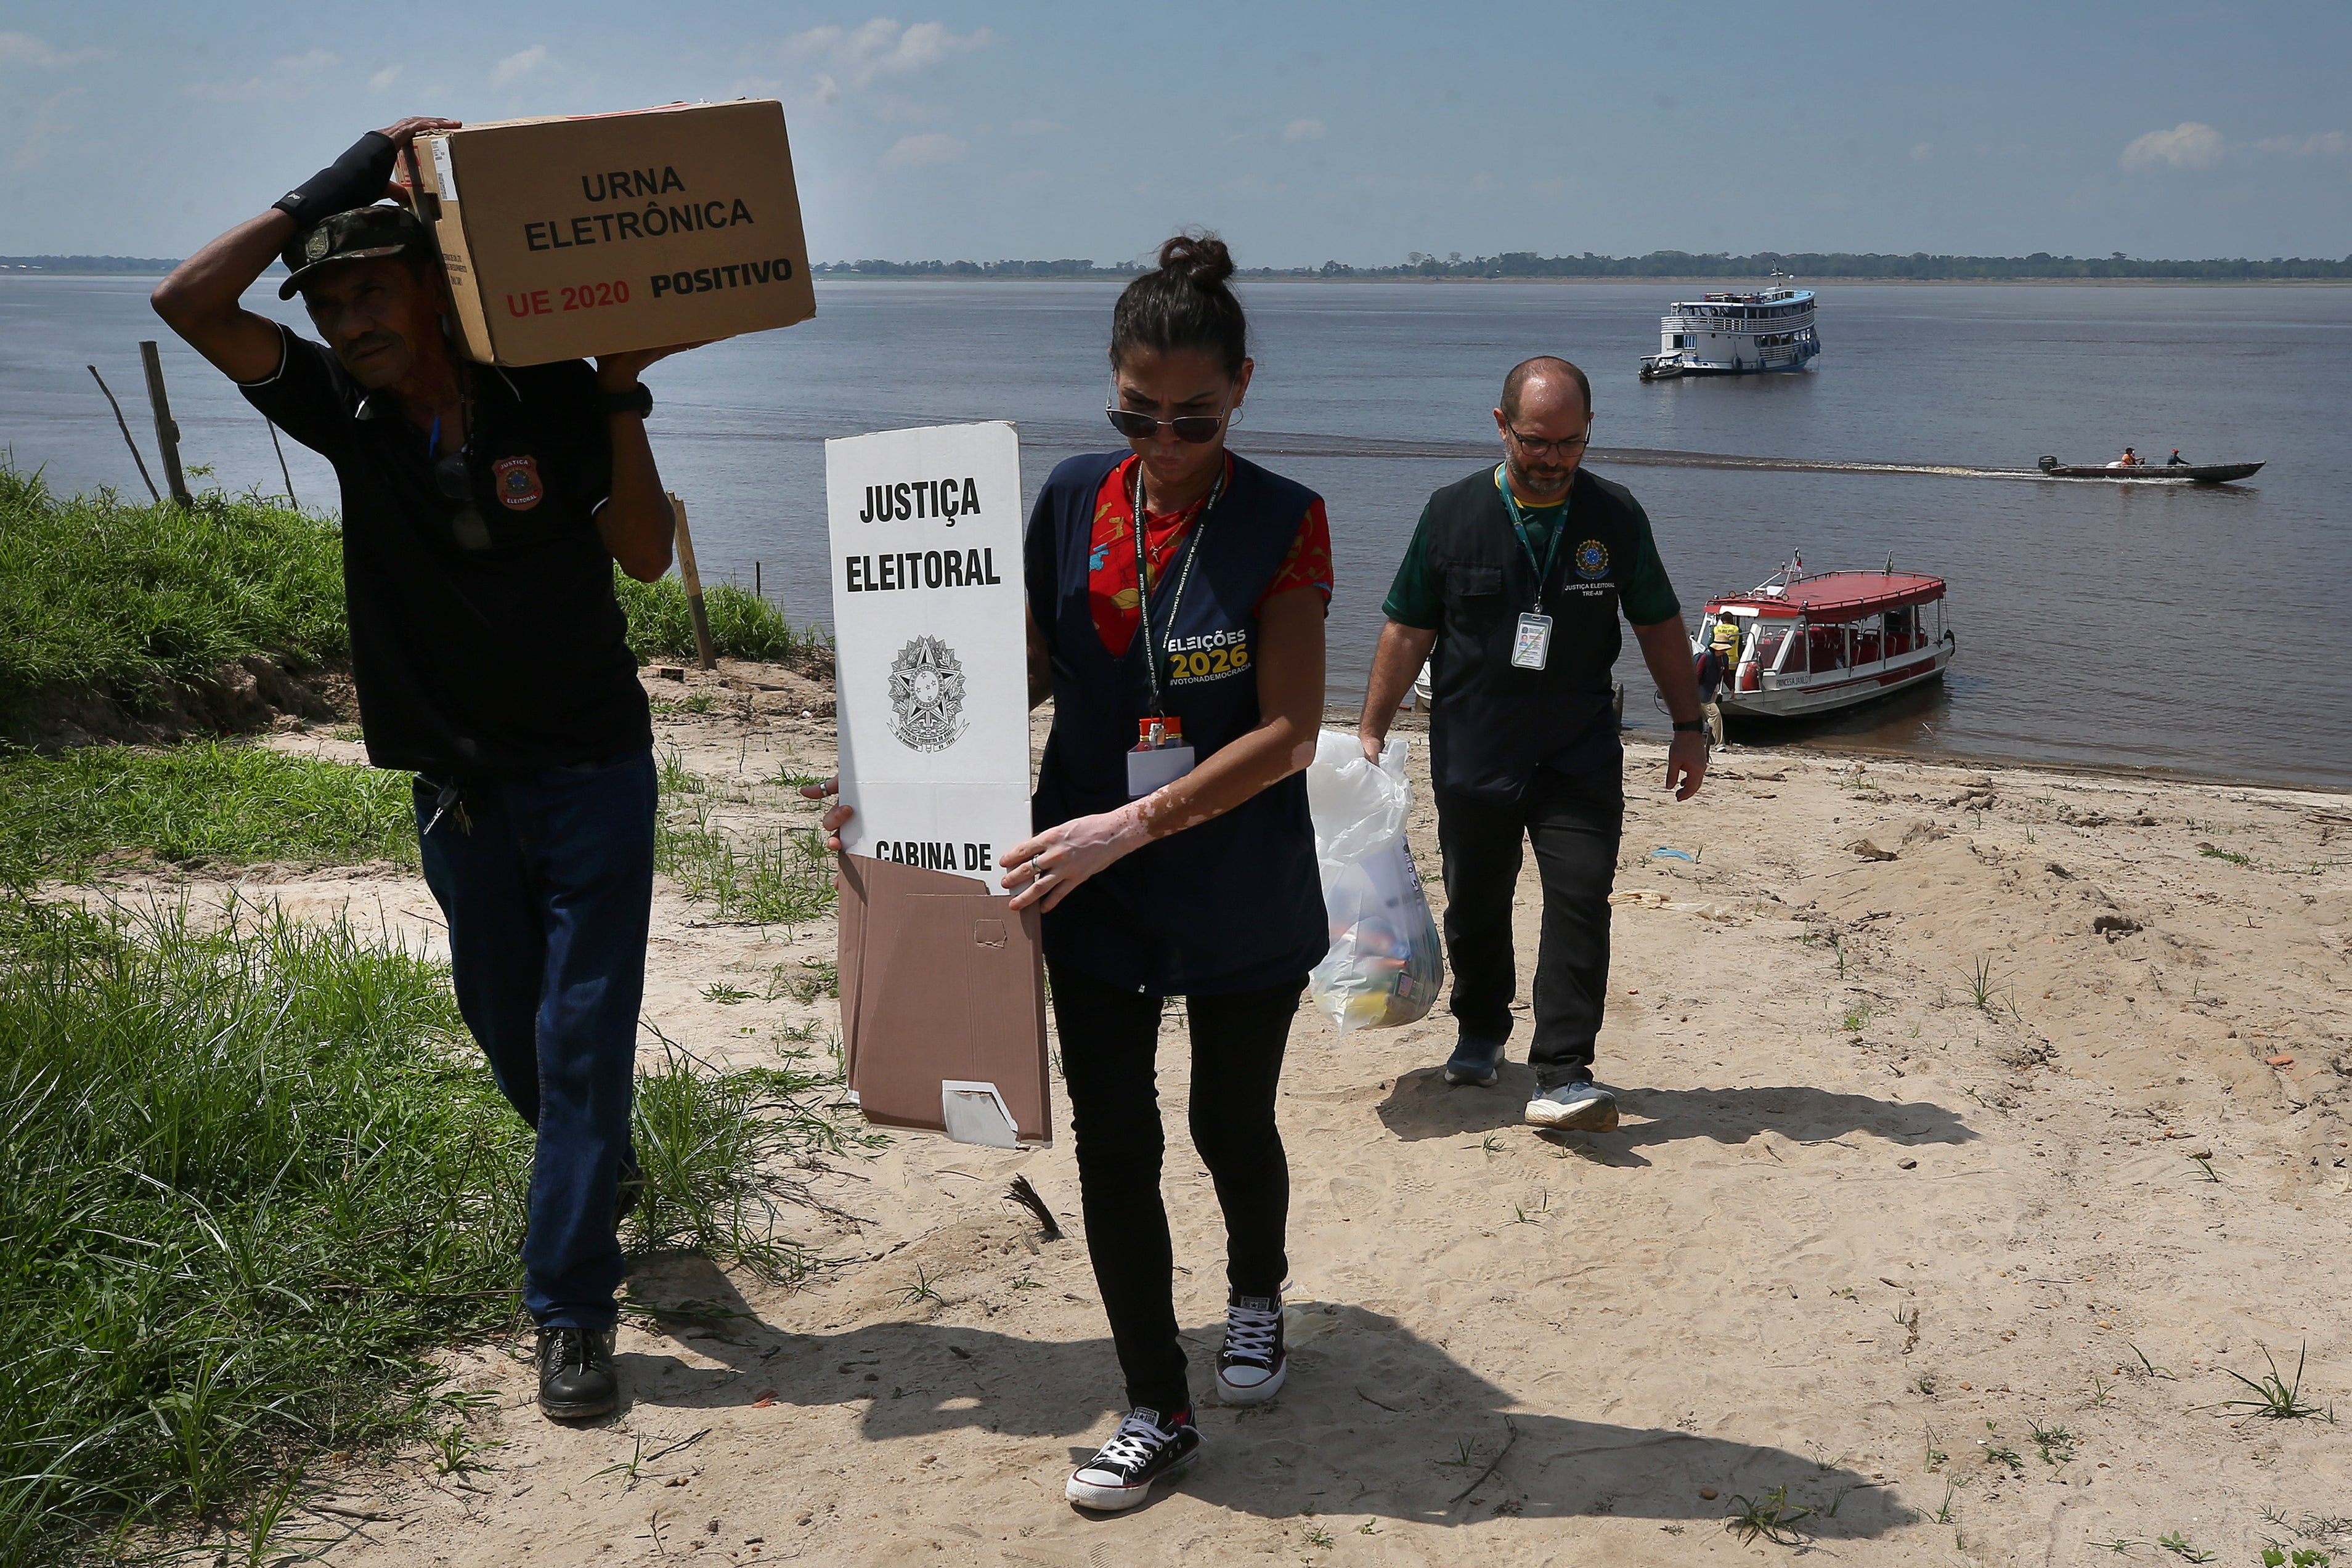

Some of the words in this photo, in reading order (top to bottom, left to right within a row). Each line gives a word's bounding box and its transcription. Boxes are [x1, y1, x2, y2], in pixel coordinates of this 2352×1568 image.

[582, 166, 685, 202] URNA
[524, 198, 754, 251] ELETRÔNICA
[507, 290, 553, 318] UE
[560, 280, 630, 312] 2020
[650, 258, 793, 298] POSITIVO
[507, 494, 537, 504] ELEITORAL
[860, 477, 981, 527] JUSTIÇA
[846, 547, 1001, 593] ELEITORAL
[1184, 553, 1194, 571] JUSTIÇA
[1176, 572, 1187, 596] ELEITORAL
[1168, 629, 1247, 652] ELEIÇÕES
[1170, 643, 1248, 678] 2026
[1170, 662, 1252, 686] #VOTONADEMOCRACIA
[876, 840, 958, 871] CABINA
[964, 843, 992, 872] DE
